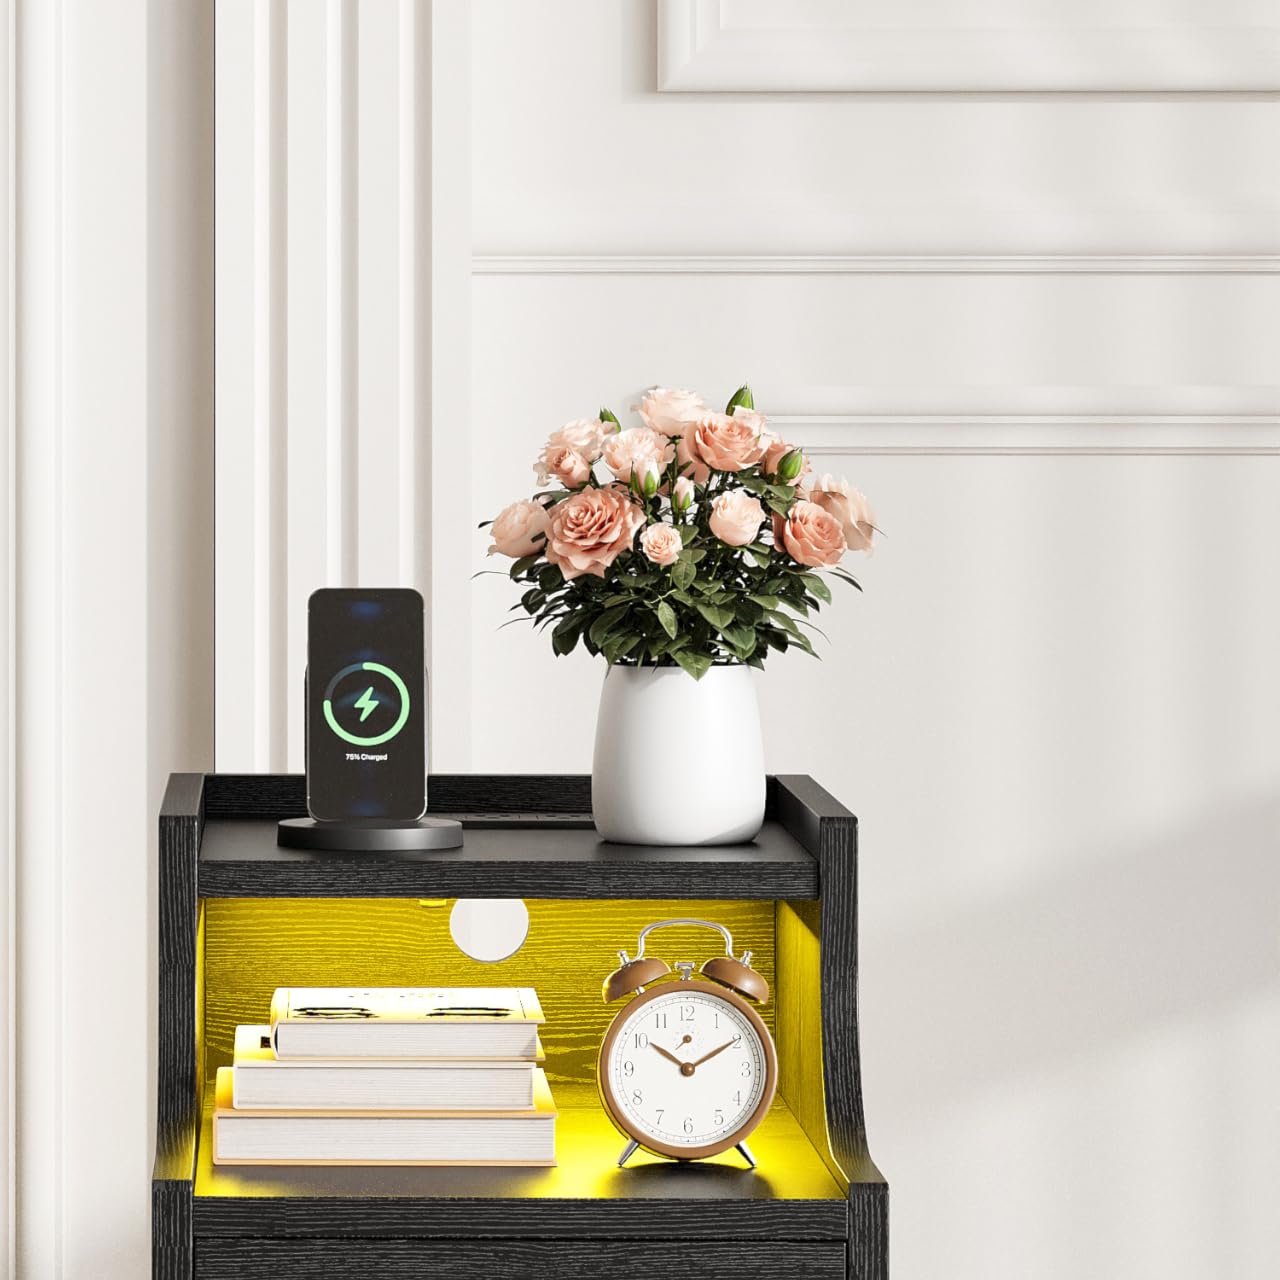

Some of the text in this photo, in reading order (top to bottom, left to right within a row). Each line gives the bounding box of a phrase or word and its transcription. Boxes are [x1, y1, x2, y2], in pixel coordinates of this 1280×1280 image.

[345, 753, 388, 762] 75% Charged
[656, 1013, 666, 1028] 11
[680, 1006, 695, 1021] 12
[635, 1033, 648, 1048] 10
[733, 1033, 741, 1048] 2
[624, 1061, 633, 1076] 9
[742, 1061, 751, 1077] 3
[633, 1089, 642, 1104] 8
[733, 1090, 742, 1105] 4
[656, 1110, 664, 1125] 7
[714, 1110, 723, 1125] 5
[684, 1118, 693, 1133] 6
